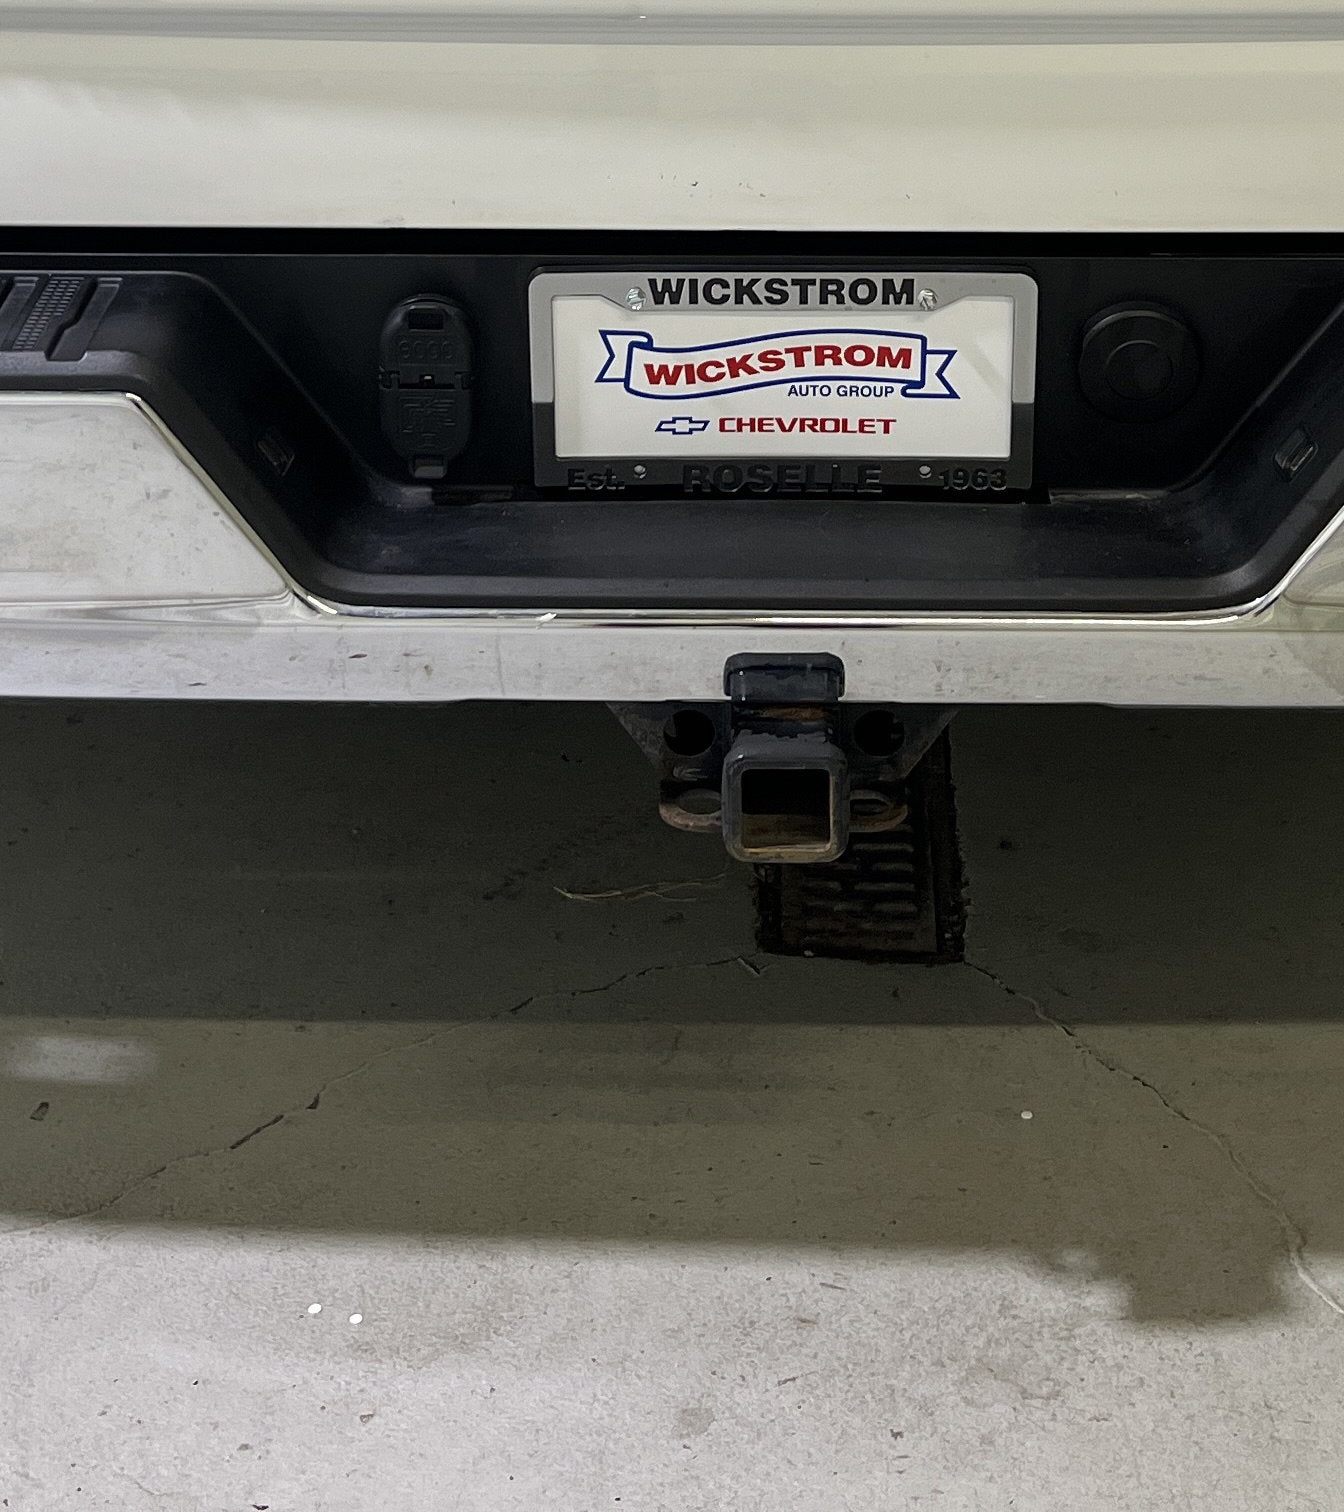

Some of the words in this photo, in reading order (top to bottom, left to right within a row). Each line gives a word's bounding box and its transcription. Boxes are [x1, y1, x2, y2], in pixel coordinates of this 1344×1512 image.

[647, 277, 916, 306] WICKSTROM
[643, 344, 913, 387] WICKSTROM
[787, 384, 834, 399] AUTO
[837, 384, 895, 399] GROUP
[717, 417, 897, 435] CHEVROLET
[567, 468, 626, 491] Est.
[682, 463, 883, 493] ROSELLE
[937, 467, 1009, 492] 1963
